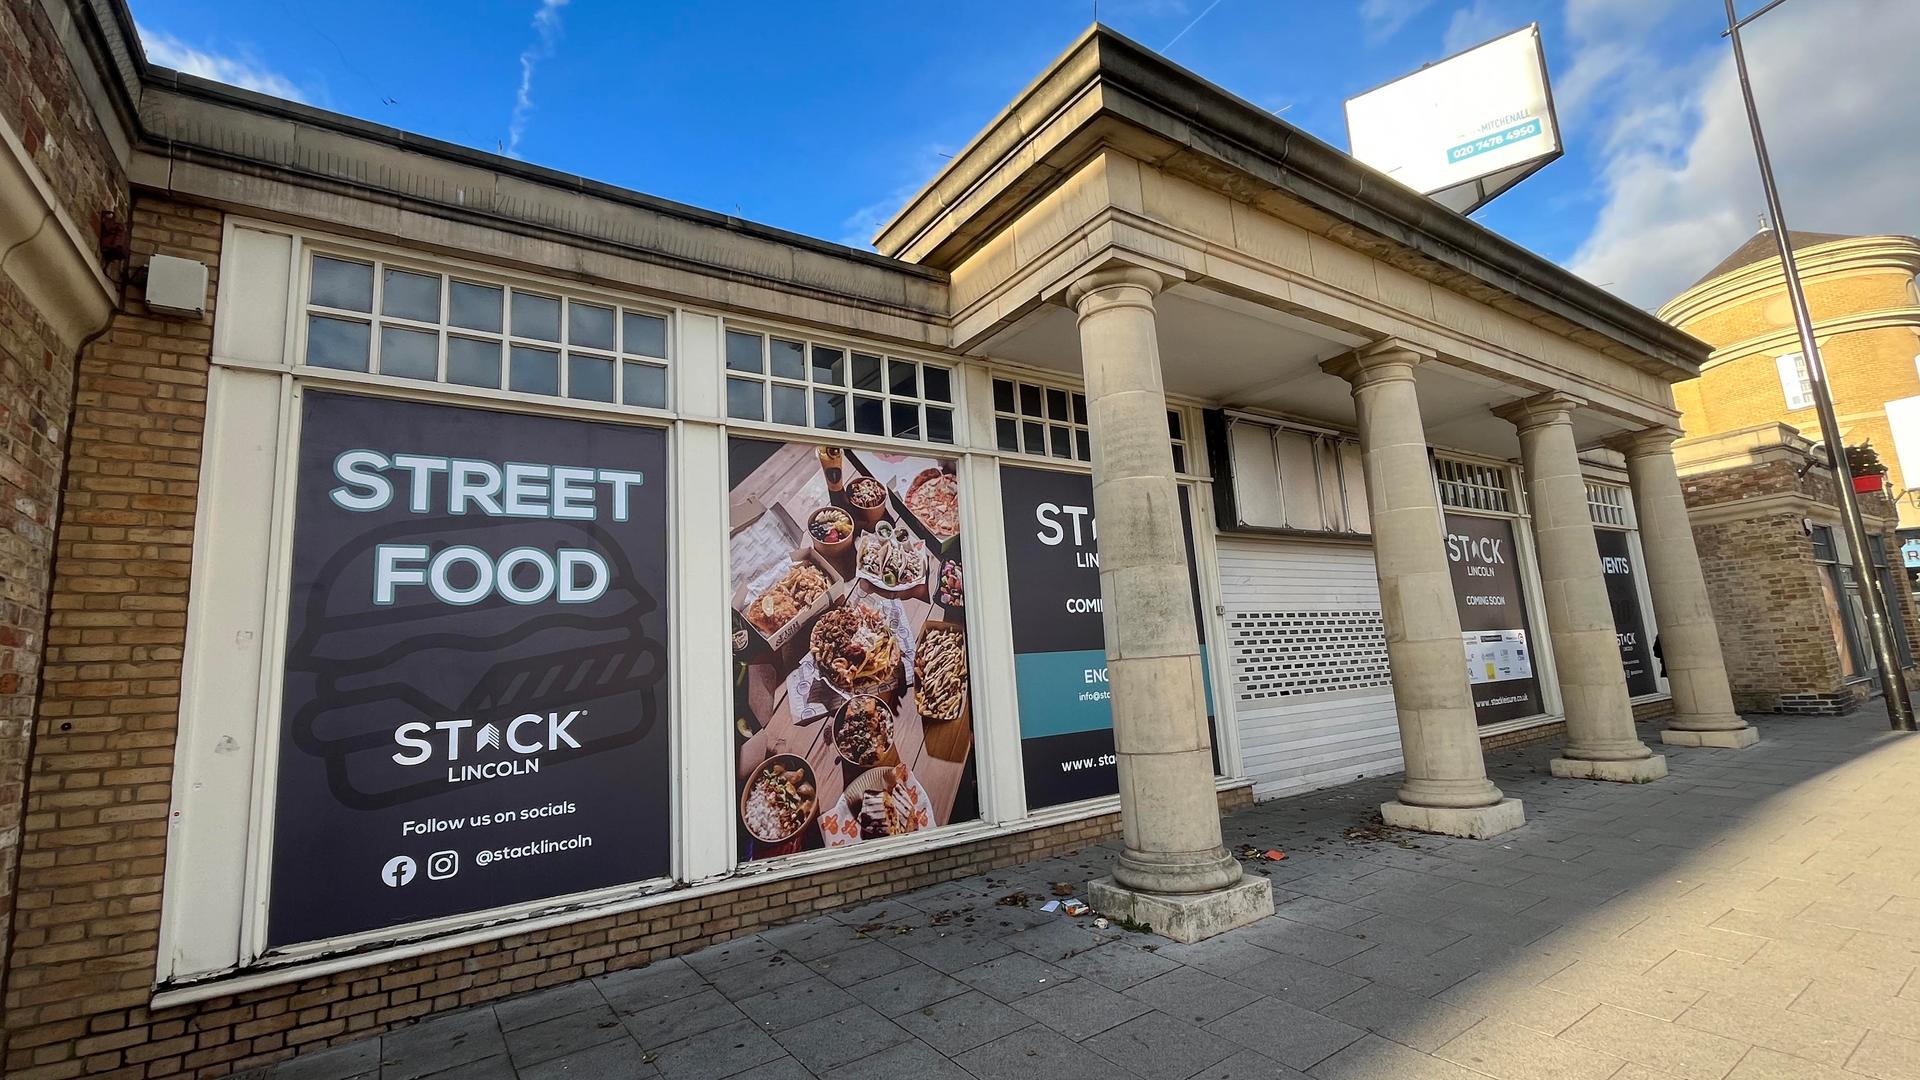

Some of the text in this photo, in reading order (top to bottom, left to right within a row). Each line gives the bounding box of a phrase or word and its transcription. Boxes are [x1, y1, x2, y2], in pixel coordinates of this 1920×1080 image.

[1453, 145, 1474, 159] 020
[1505, 124, 1536, 141] 4950
[329, 449, 643, 522] STREET
[373, 544, 611, 606] FOOD
[1466, 565, 1495, 577] LINCOLN
[1466, 595, 1506, 606] COMING SOON
[448, 758, 539, 783] LINCOLN
[402, 801, 576, 836] Follow us on socials
[475, 834, 592, 867] @stacklincoln
